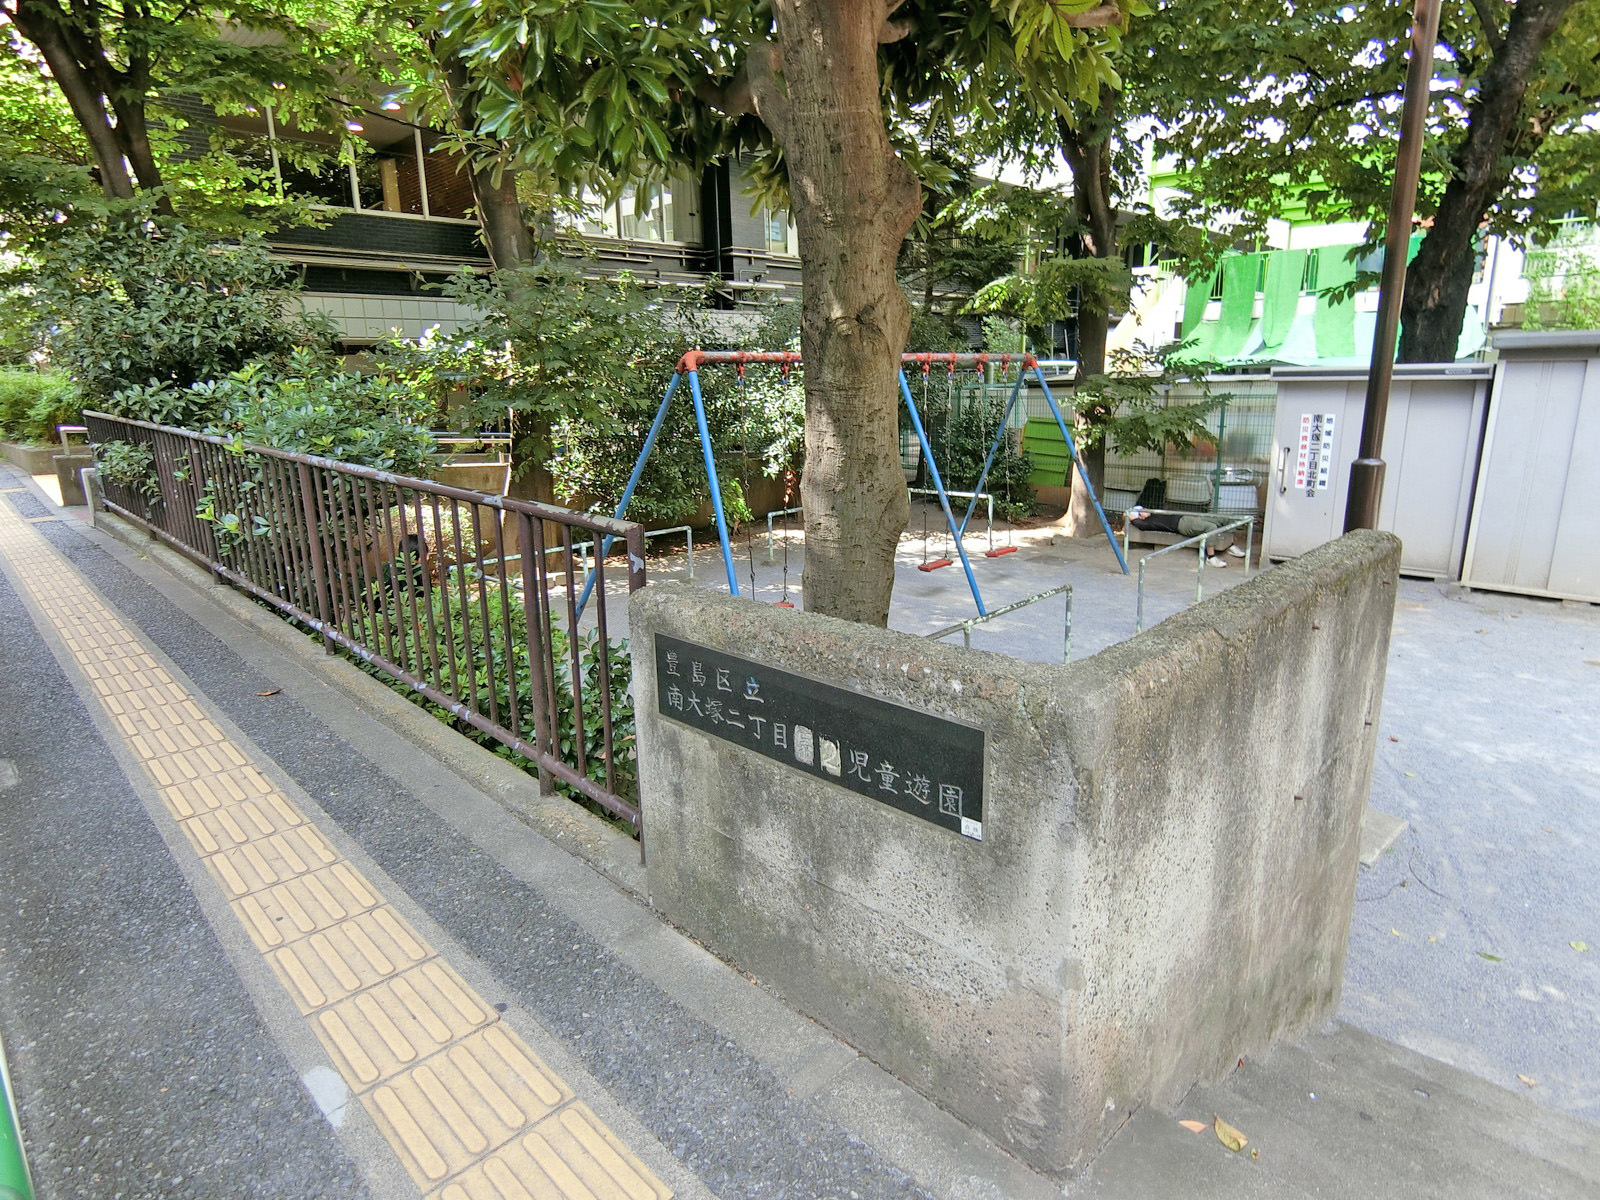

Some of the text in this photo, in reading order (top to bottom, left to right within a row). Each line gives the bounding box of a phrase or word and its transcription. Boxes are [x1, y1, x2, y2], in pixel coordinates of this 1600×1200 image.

[1306, 414, 1323, 497] 南大塚二丁目北町会
[666, 650, 764, 703] 豊島区立
